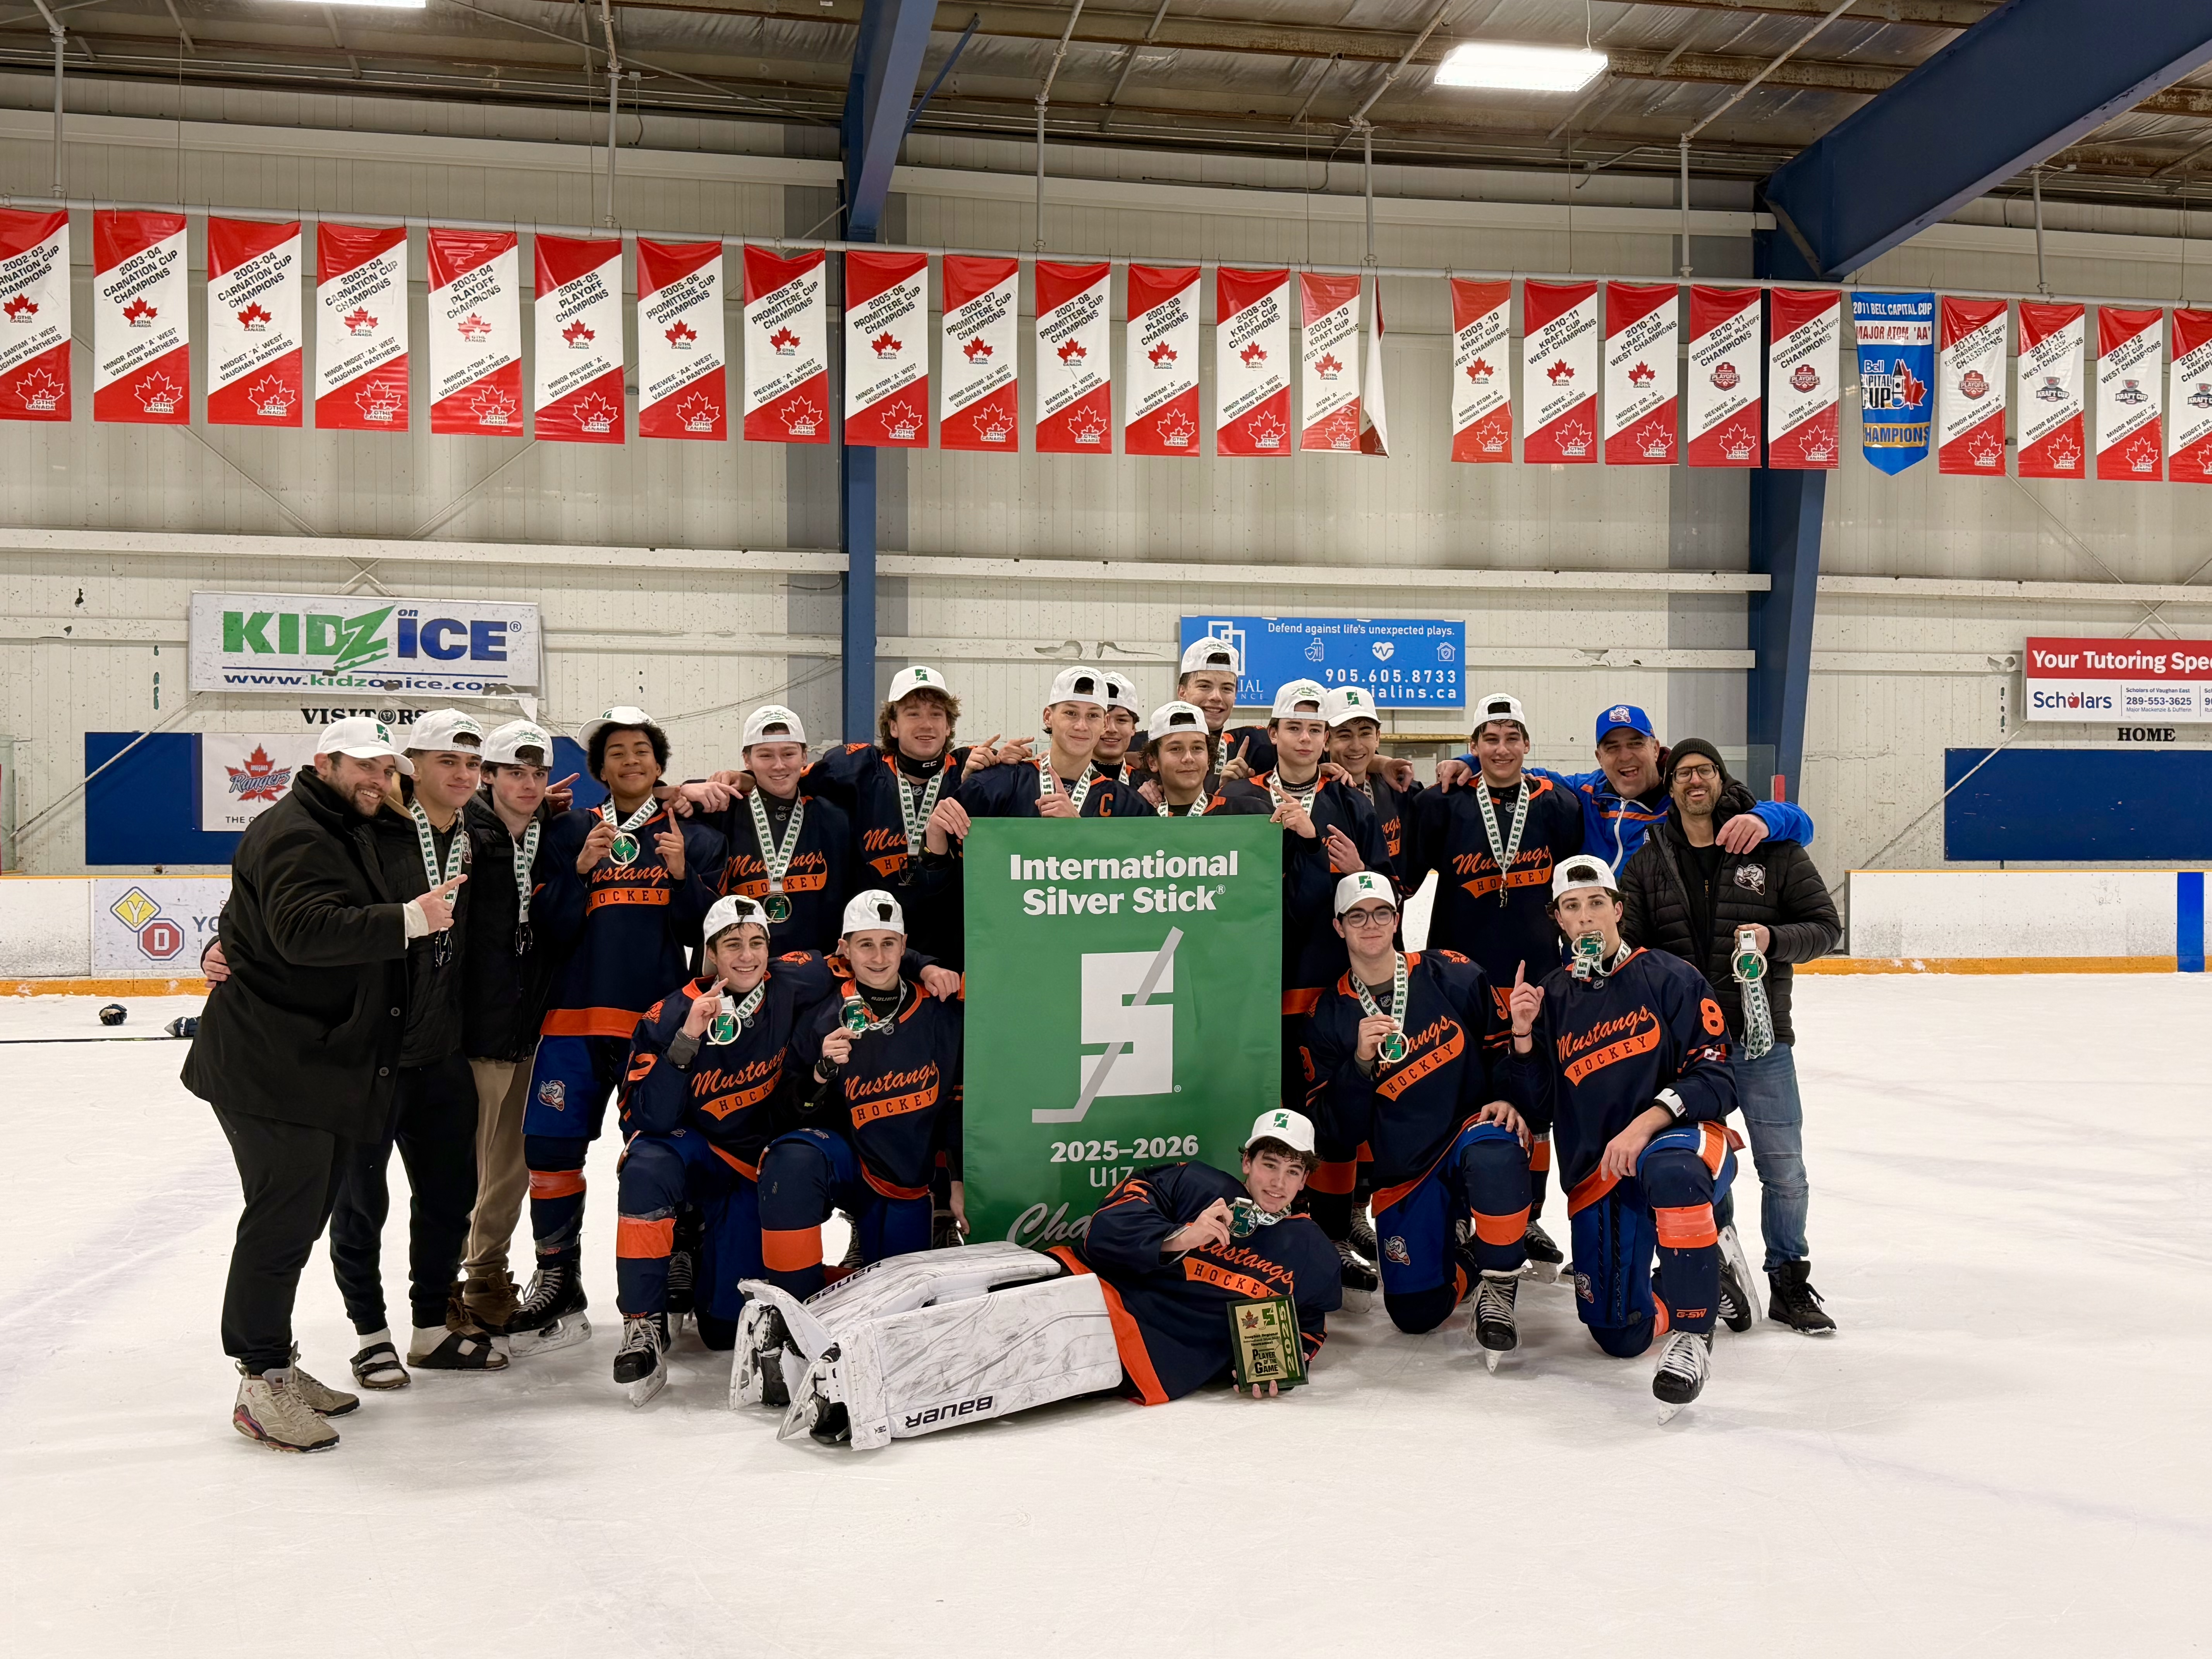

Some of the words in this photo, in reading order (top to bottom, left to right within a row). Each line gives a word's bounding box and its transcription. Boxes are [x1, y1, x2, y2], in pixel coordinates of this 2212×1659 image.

[103, 262, 157, 297] CARNATION
[158, 250, 178, 265] CUP
[119, 246, 162, 276] 2003-04
[234, 251, 276, 280] 2003-04
[114, 268, 170, 304] CHAMPIONS
[218, 267, 271, 301] CARNATION
[273, 255, 292, 271] CUP
[228, 273, 285, 308] CHAMPIONS
[558, 272, 599, 297] 2004-05
[766, 279, 804, 304] 2005-06
[556, 289, 609, 323] CHAMPIONS
[559, 280, 603, 309] PLAYOFF
[752, 292, 801, 325] PROMITTERE
[802, 281, 818, 297] CUP
[1055, 294, 1091, 318] 2007-08
[1853, 302, 1870, 314] 2011
[1871, 303, 1887, 315] BELL
[1887, 303, 1917, 315] CAPITAL
[1918, 303, 1932, 315] CUP
[763, 297, 813, 330] CHAMPIONS
[1039, 308, 1088, 339] PROMITTERE
[1088, 295, 1104, 309] CUP
[1230, 315, 1258, 338] KRAFT
[1261, 303, 1278, 318] CUP
[1236, 297, 1273, 324] 2008-09
[1543, 309, 1579, 336] 2010-11
[1051, 310, 1099, 343] CHAMPIONS
[1229, 313, 1280, 349] CHAMPIONS
[1528, 348, 1550, 365] WEST
[1552, 318, 1597, 349] CHAMPIONS
[1539, 330, 1564, 349] KRAFT
[1566, 319, 1580, 333] CUP
[1772, 335, 1812, 363] SCOTIABANK
[1813, 318, 1839, 337] PLAYOFF
[1789, 318, 1824, 343] 2010-11
[1856, 326, 1884, 340] MAJOR
[1887, 326, 1909, 339] ATOM
[103, 356, 125, 371] MINOR
[127, 345, 144, 358] ATOM
[157, 328, 177, 341] WEST
[110, 358, 143, 376] VAUGHAN
[144, 337, 179, 358] PANTHERS
[220, 353, 247, 371] MIDGET
[262, 333, 283, 348] WEST
[1780, 333, 1832, 368] CHAMPIONS
[2022, 364, 2041, 381] WEST
[2042, 337, 2083, 367] CHAMPIONS
[2030, 330, 2066, 358] 2011-12
[2036, 349, 2053, 362] KRAFT
[2054, 340, 2066, 351] CUP
[220, 360, 255, 381] VAUGHAN
[256, 340, 293, 362] PANTHERS
[1864, 360, 1884, 373] Bell
[753, 378, 782, 397] PEEWEE
[795, 358, 815, 373] WEST
[757, 383, 789, 404] VAUGHAN
[790, 364, 822, 386] PANTHERS
[1538, 407, 1562, 424] VAUGHAN
[1562, 392, 1586, 409] PANTHERS
[1541, 396, 1566, 414] PEEWEE
[1781, 414, 1804, 431] VAUGHAN
[1804, 400, 1829, 417] PANTHERS
[1864, 428, 1929, 443] HAMPIONS
[398, 608, 419, 617] on
[223, 605, 397, 669] KIDZ
[1268, 623, 1302, 634] Defend
[1305, 623, 1341, 635] against
[1343, 624, 1366, 634] life's
[1369, 625, 1424, 637] unexpected
[1427, 625, 1455, 637] plays.
[1326, 668, 1456, 683] 905.605.8733
[2032, 650, 2079, 668] Your
[2083, 649, 2167, 673] Tutoring
[2171, 652, 2212, 673] Spe
[2126, 697, 2192, 705] 289-553-3625
[2118, 727, 2176, 742] HOME
[229, 771, 292, 793] Rangers
[1099, 793, 1113, 817] C
[1010, 849, 1238, 880] International
[1453, 845, 1550, 875] Musangs
[747, 875, 819, 895] HOKEY
[1477, 870, 1544, 891] HOKEY
[588, 890, 663, 908] HOCKEY
[1023, 886, 1125, 915] Silver
[1700, 998, 1725, 1036] 8
[1557, 1005, 1653, 1063] Mustangs
[1386, 1044, 1454, 1094] HOCKEY
[1573, 1036, 1646, 1077] HOCKEY
[718, 1074, 778, 1112] HOCKE
[856, 1089, 933, 1121] HOCKEY
[806, 1262, 882, 1305] BAUER
[1279, 1305, 1295, 1371] 2025
[905, 1395, 993, 1429] BAUER
